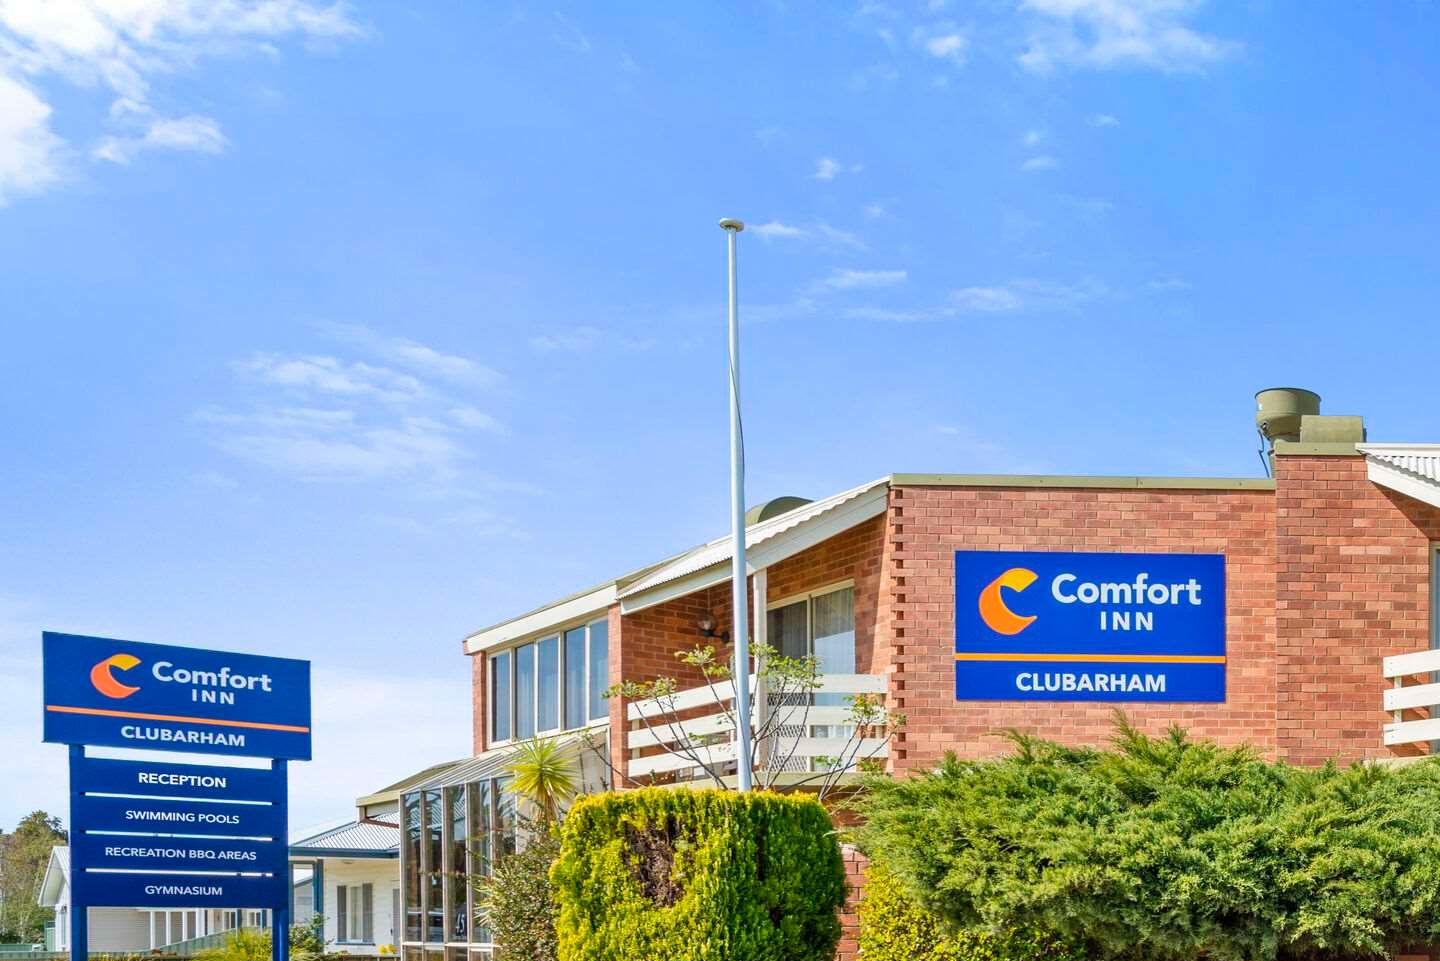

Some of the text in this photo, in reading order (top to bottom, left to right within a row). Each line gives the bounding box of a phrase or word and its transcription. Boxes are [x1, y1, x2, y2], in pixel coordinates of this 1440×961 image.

[1051, 572, 1202, 605] Comfort
[1100, 612, 1153, 630] INN
[151, 661, 272, 692] Comfort
[1015, 672, 1166, 692] CLUBARHAM
[192, 688, 235, 705] INN
[121, 725, 245, 747] CLUBARHAM
[138, 772, 226, 788] RECEPTION
[126, 810, 240, 825] SWIMMING POOLS
[105, 846, 257, 860] RECREATION BBQ AREAS
[145, 885, 223, 896] GYMNASIUM
